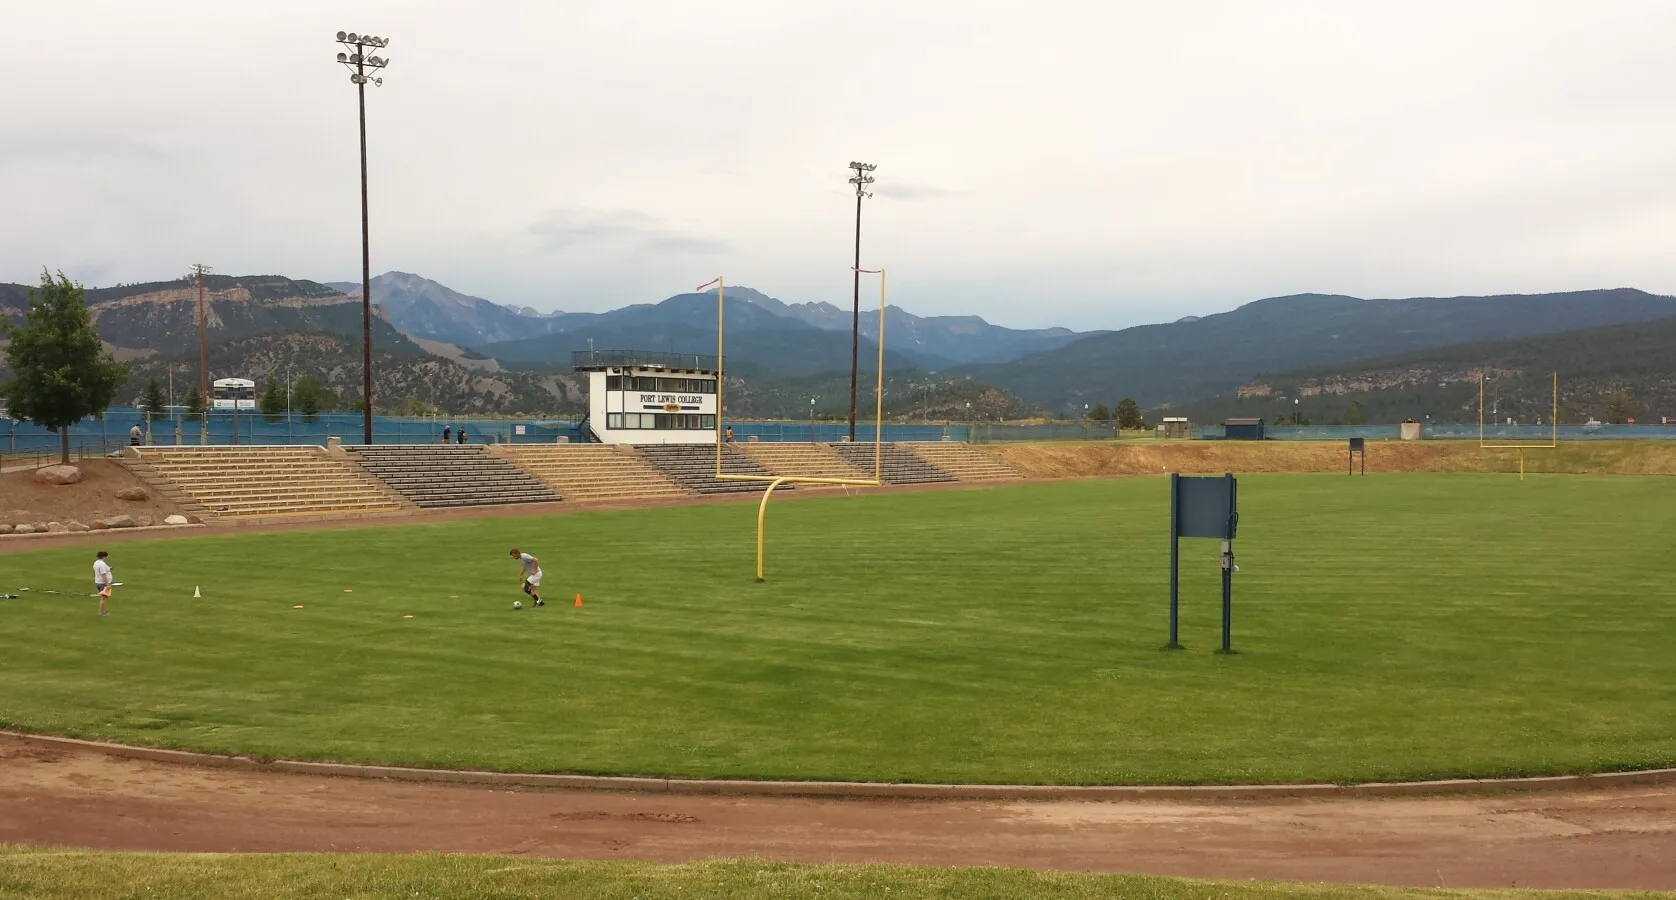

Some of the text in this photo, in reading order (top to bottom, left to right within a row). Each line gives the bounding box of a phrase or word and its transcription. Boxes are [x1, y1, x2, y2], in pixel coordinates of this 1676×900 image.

[640, 394, 702, 404] FORT LEWIS COLLEGE
